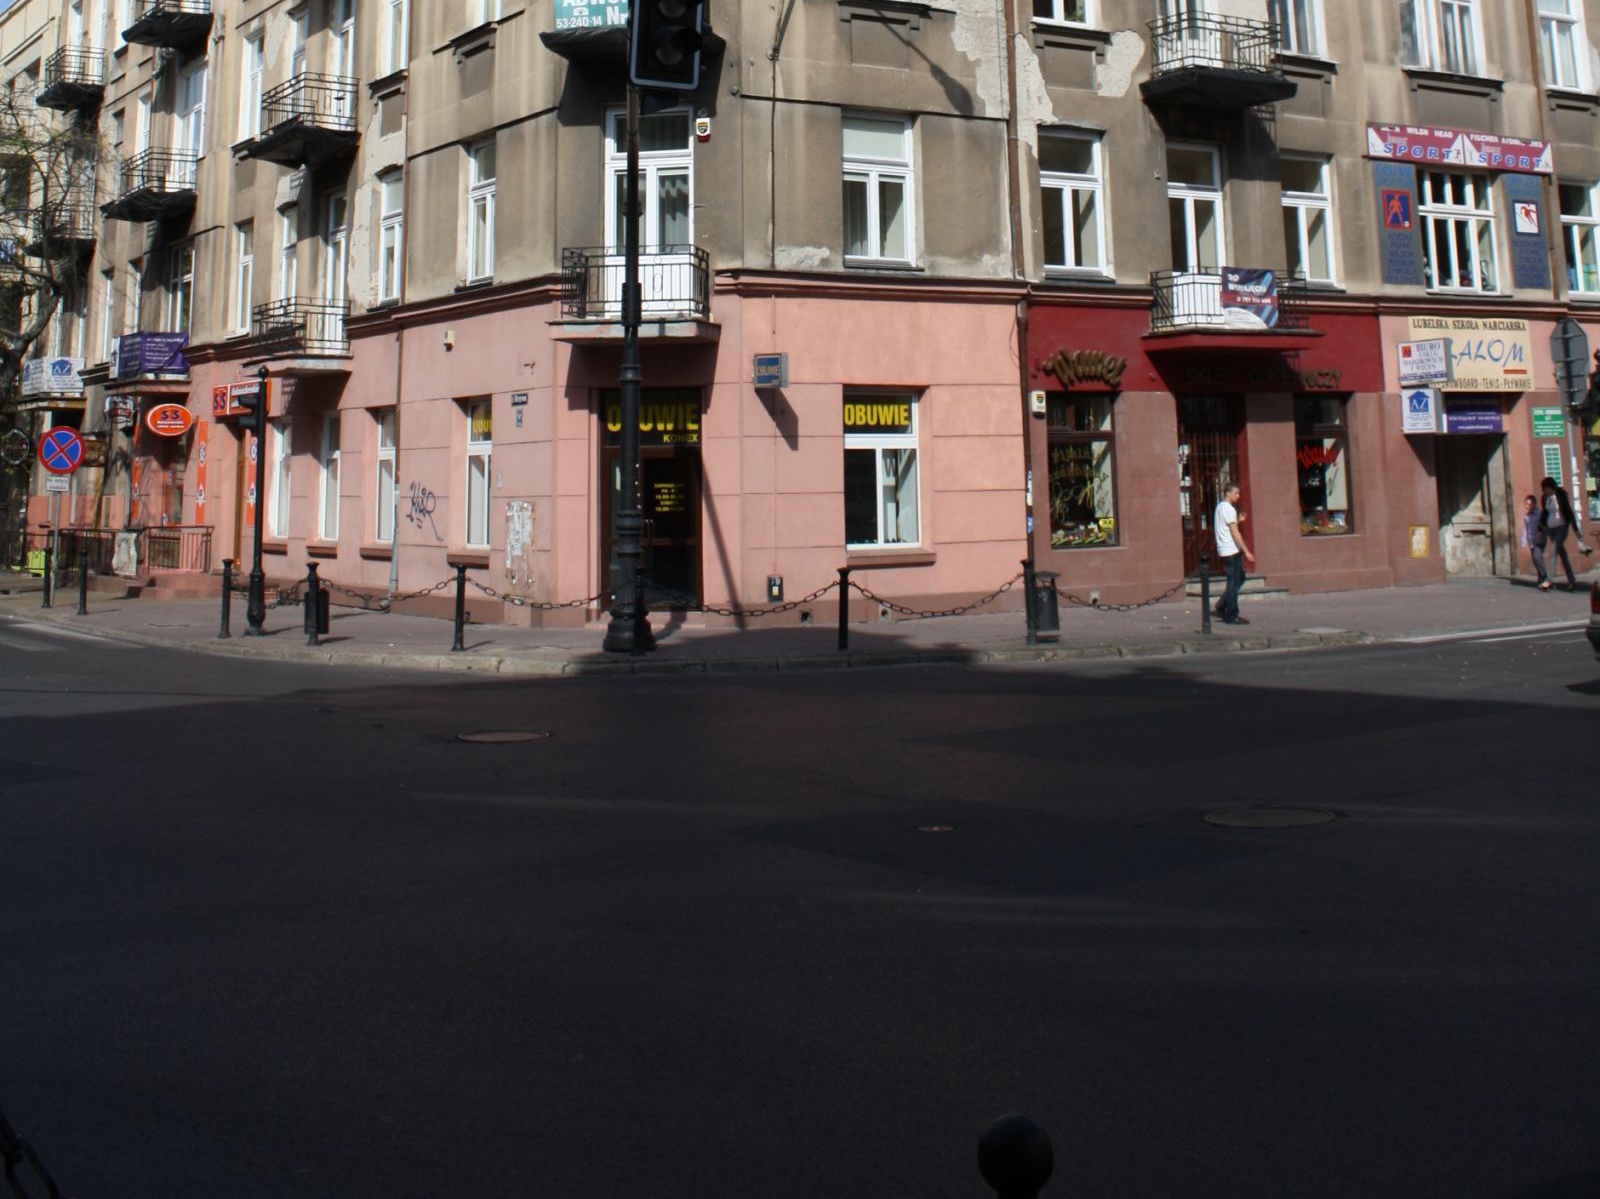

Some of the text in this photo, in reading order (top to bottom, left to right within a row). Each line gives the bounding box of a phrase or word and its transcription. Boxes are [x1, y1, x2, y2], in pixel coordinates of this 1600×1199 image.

[606, 6, 629, 25] Nr
[1383, 143, 1453, 161] SPORT
[1477, 152, 1543, 168] SPORT
[1413, 318, 1449, 330] LUBELSKA
[1483, 321, 1527, 332] NARCIARSKA
[1450, 338, 1524, 368] LALOM
[607, 404, 699, 431] OUWIE
[844, 404, 909, 426] OBUWIE
[663, 434, 698, 443] KONEX
